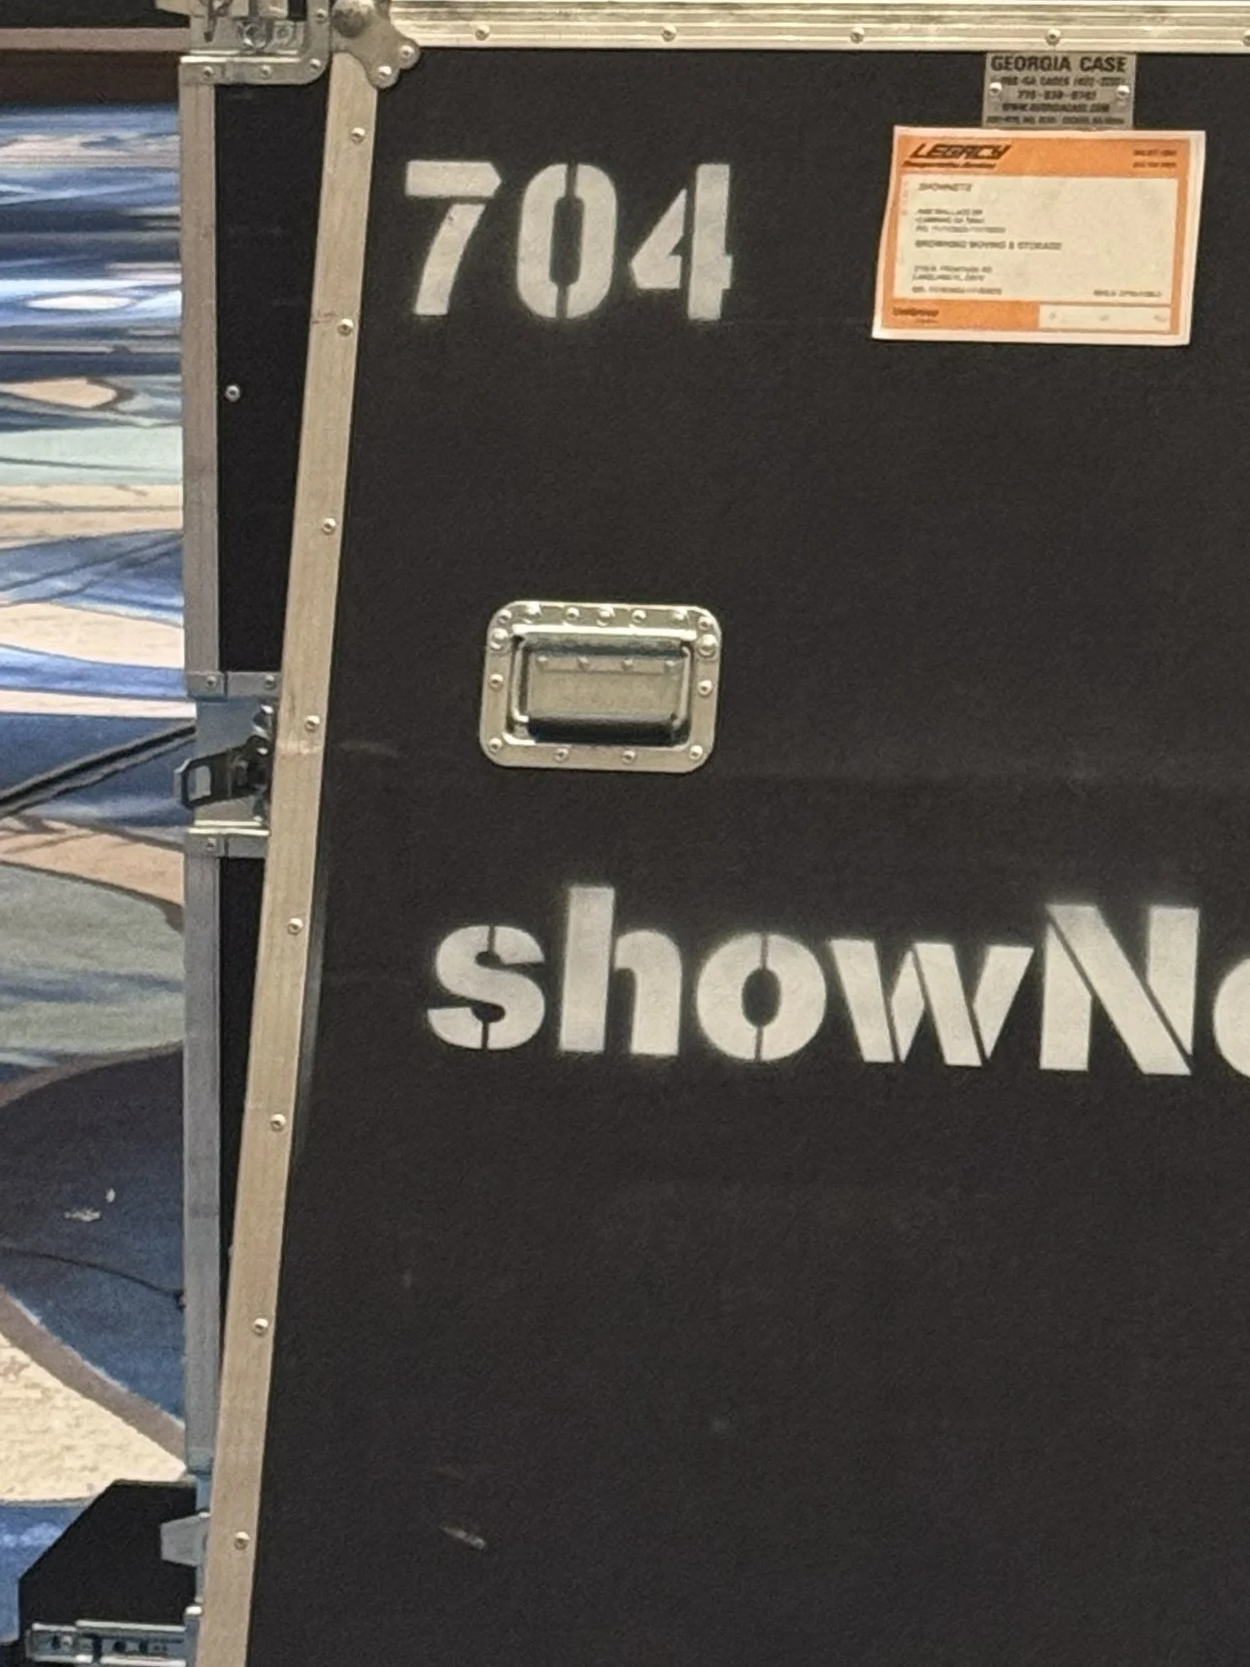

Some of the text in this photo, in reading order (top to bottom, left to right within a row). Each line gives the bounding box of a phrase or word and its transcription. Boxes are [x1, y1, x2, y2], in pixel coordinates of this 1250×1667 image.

[991, 55, 1128, 72] GEORGIA CASE
[909, 142, 1012, 160] LEGACY
[404, 160, 733, 321] 704
